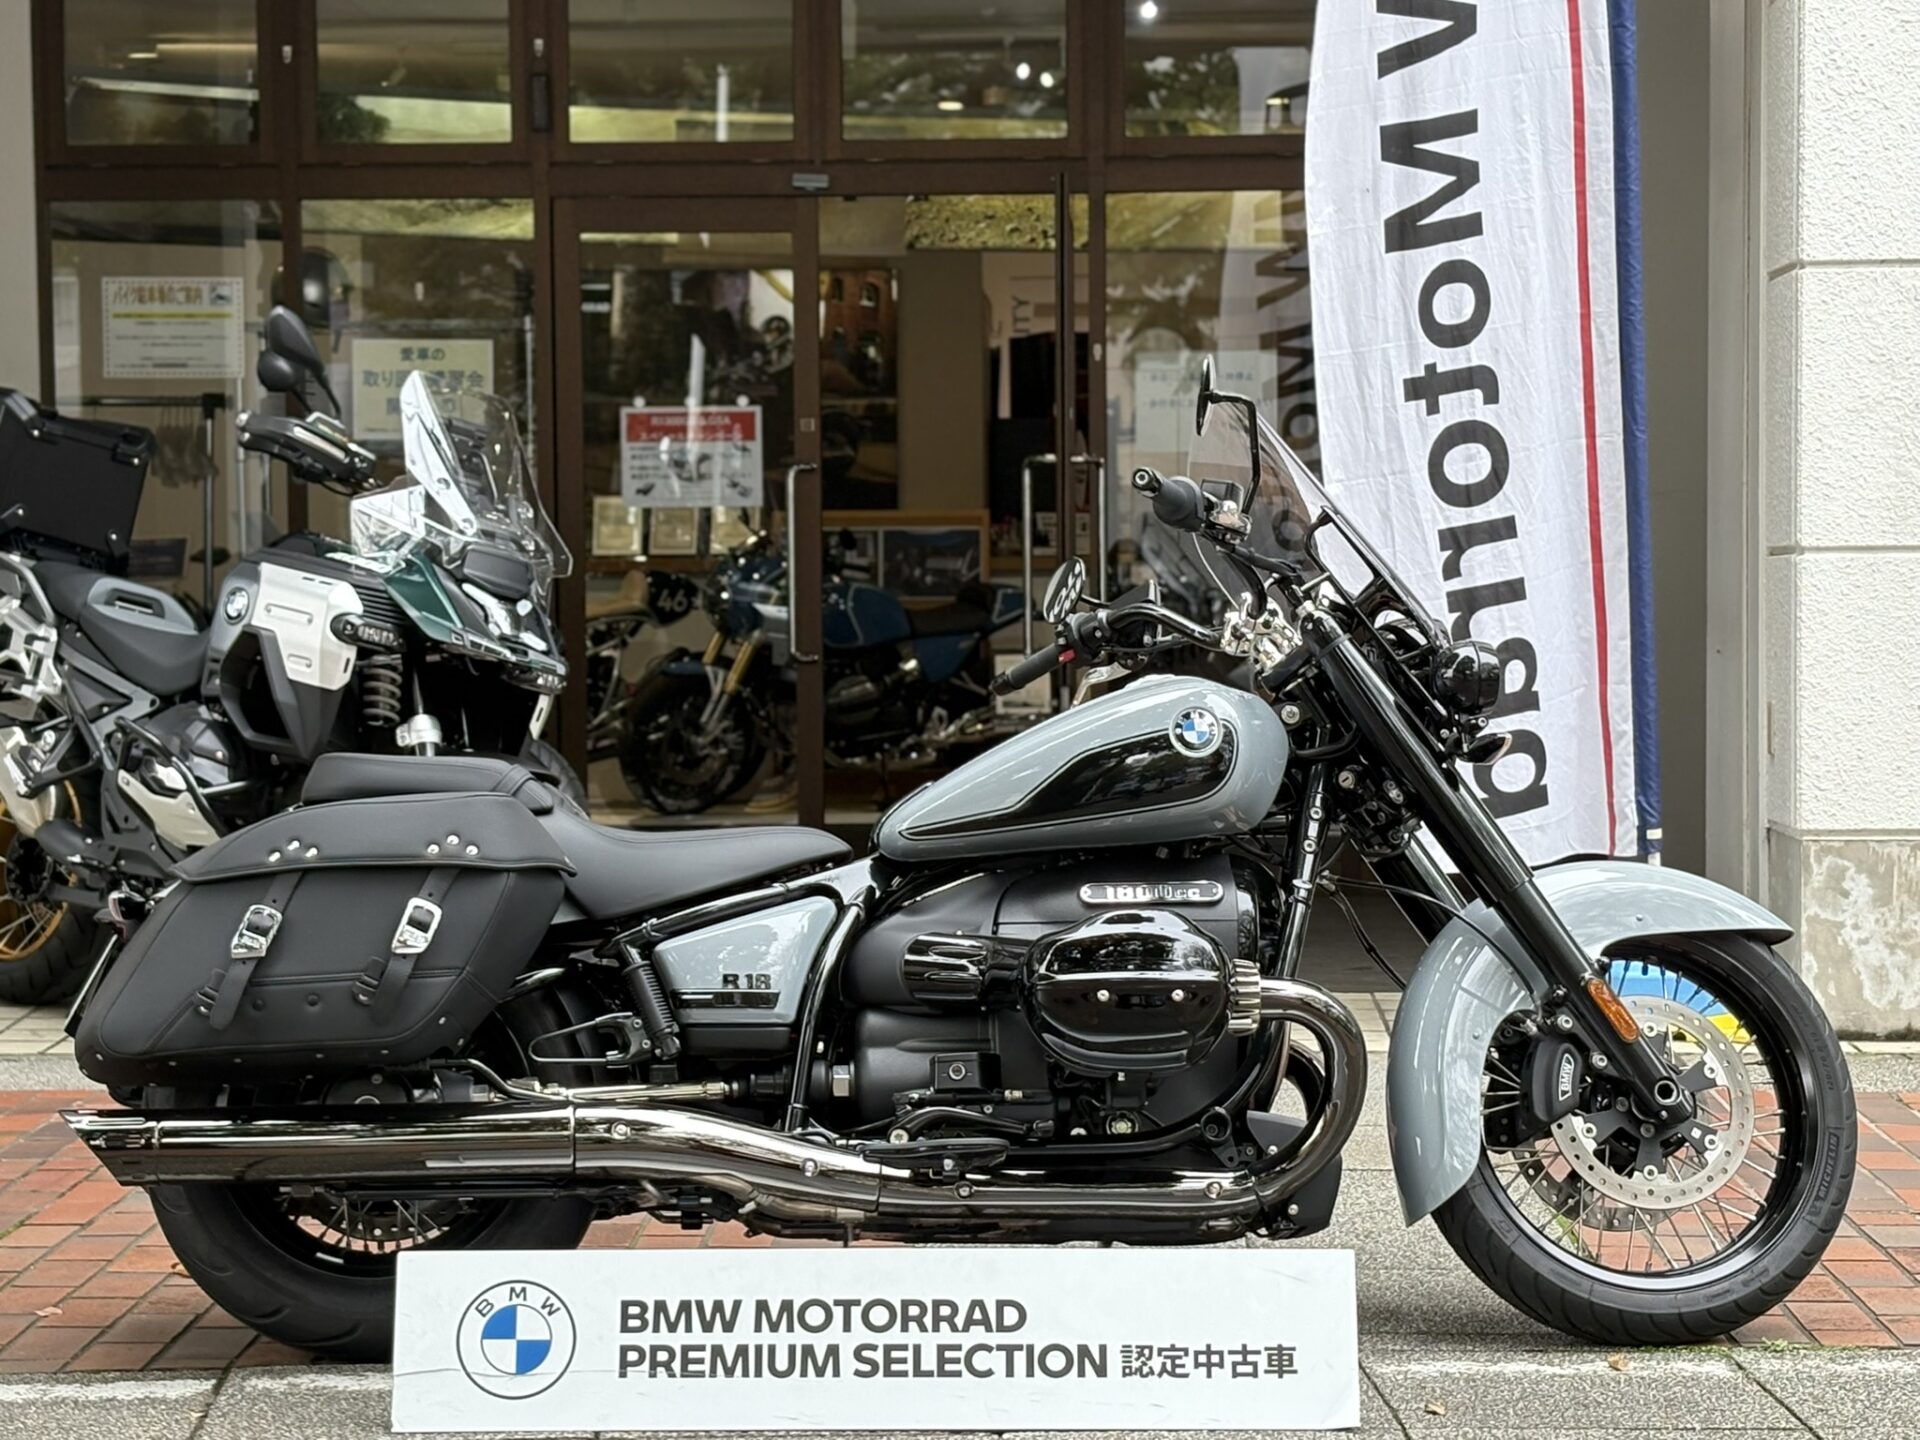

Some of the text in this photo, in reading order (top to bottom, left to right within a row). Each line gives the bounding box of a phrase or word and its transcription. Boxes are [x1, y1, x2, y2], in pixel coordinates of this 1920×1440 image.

[657, 588, 688, 612] 46
[722, 973, 771, 989] R 18
[1560, 1060, 1573, 1093] BMW
[1818, 1132, 1838, 1199] MICHELIN
[475, 1286, 561, 1318] BMW
[619, 1298, 1026, 1334] BMW MOTORRAD
[618, 1343, 1298, 1379] PREMIUM SELECTION 認定中古車
